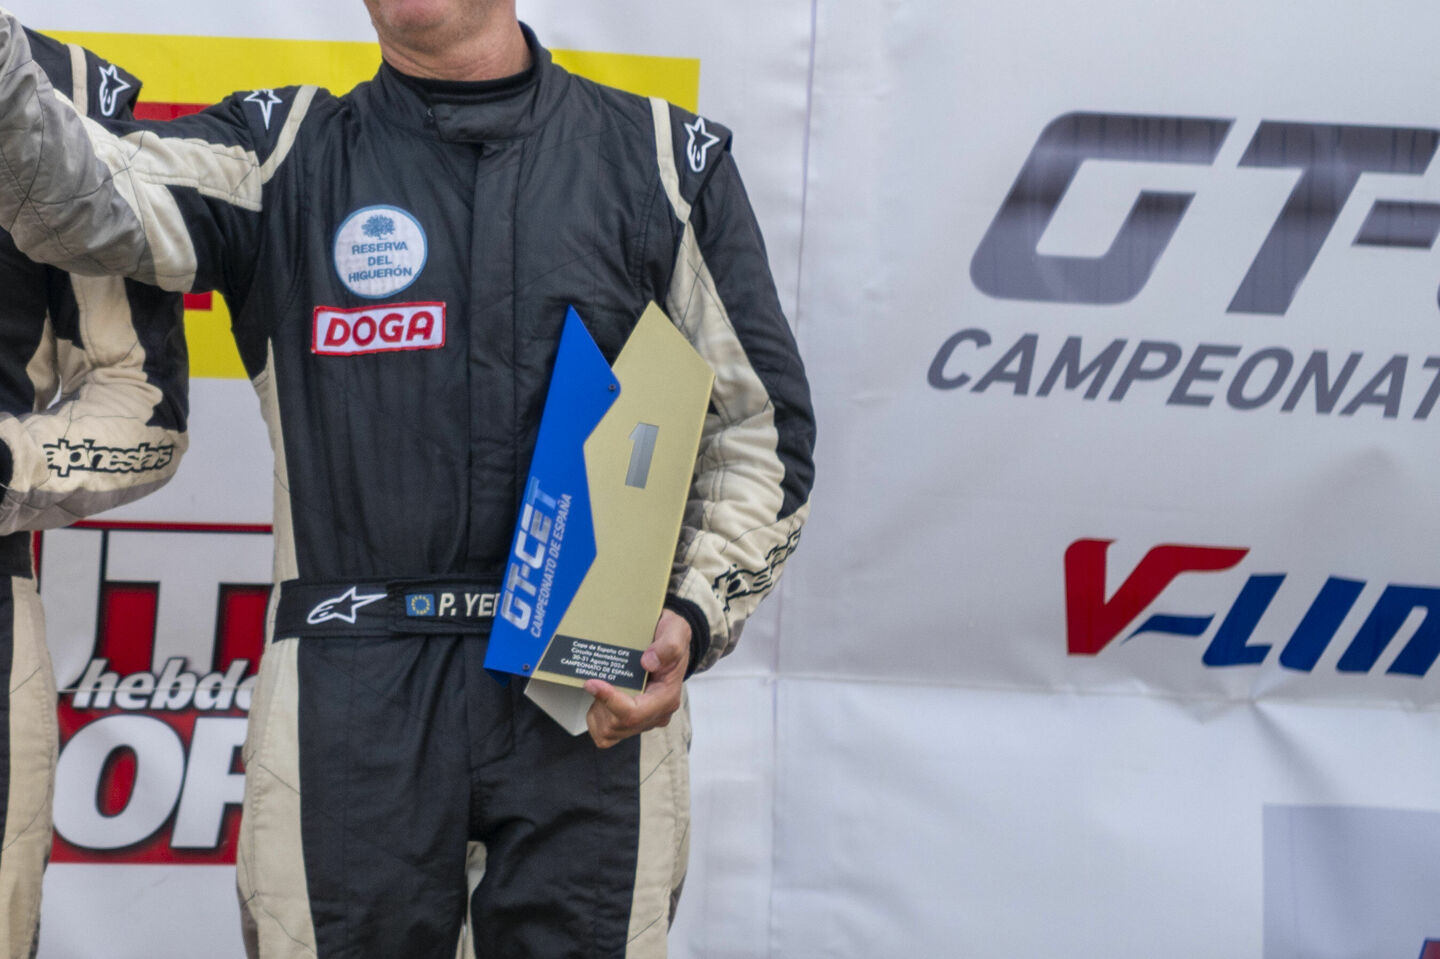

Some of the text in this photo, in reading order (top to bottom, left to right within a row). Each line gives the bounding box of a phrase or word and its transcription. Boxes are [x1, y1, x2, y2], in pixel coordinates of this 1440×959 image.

[969, 110, 1440, 316] GT-
[351, 240, 408, 255] RESERVA
[367, 256, 392, 267] DEL
[348, 265, 412, 283] HIGUERÓN
[323, 311, 434, 347] DOGA
[625, 421, 659, 489] 1
[500, 476, 557, 631] GT-CET
[530, 493, 572, 638] CAMPEONATO DE ESPAÑA
[438, 592, 457, 617] P.
[561, 658, 602, 671] CAMPEONATO
[611, 667, 634, 678] ESPAÑA
